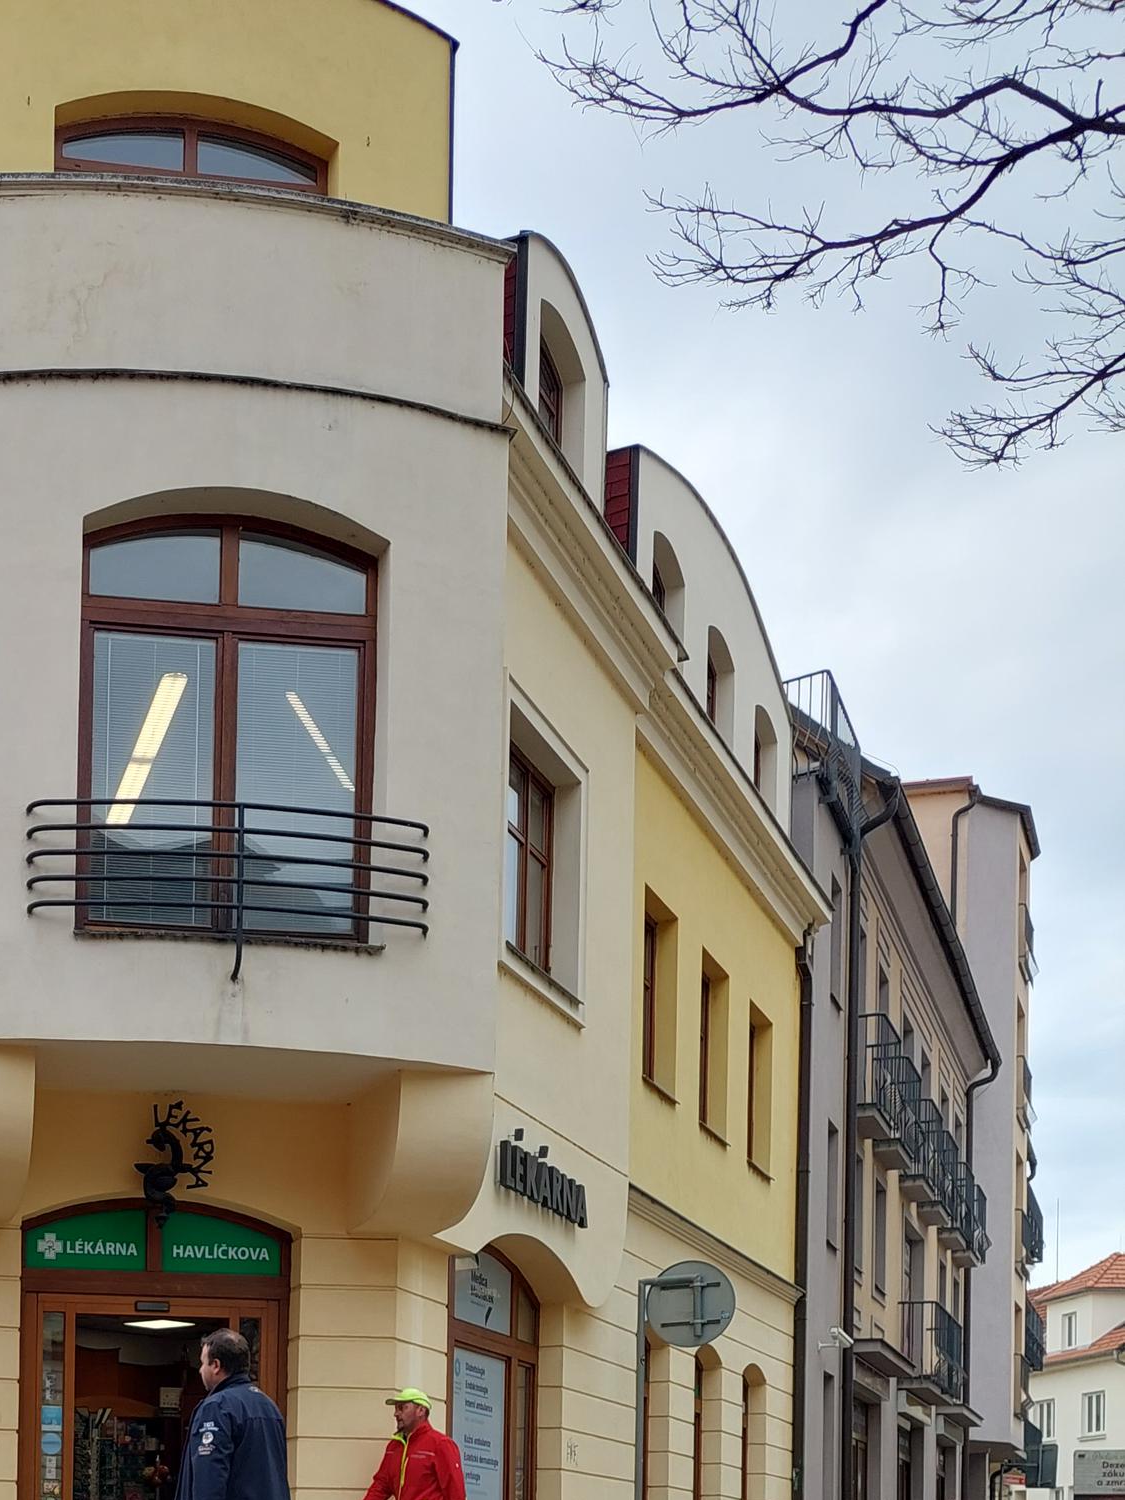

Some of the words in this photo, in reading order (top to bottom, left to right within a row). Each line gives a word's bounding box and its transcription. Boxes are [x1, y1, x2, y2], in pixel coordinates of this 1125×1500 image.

[153, 1100, 214, 1190] LÉKÁRNA
[499, 1128, 588, 1228] LÉKÁRNA
[66, 1238, 138, 1256] LÉKÁRNA
[172, 1243, 270, 1261] HAVLÍČKOVA
